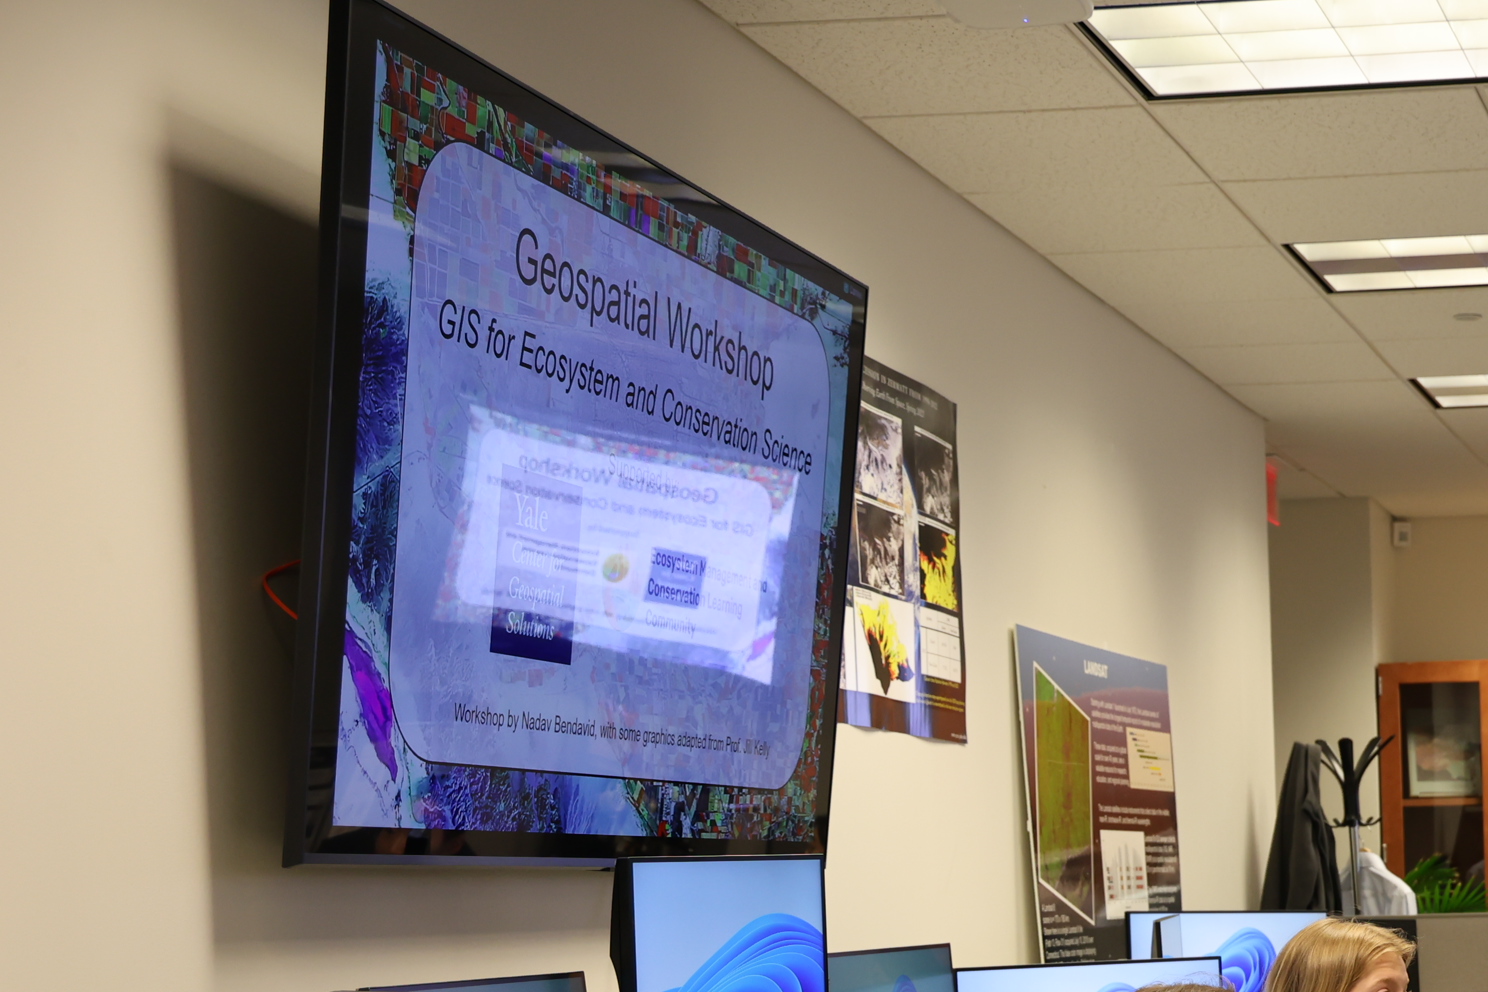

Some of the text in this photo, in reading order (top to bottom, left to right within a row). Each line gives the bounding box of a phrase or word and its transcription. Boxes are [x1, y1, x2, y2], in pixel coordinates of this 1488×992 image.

[515, 227, 774, 401] Geospatial Workshop
[439, 298, 812, 476] GIS for Ecosystem and Conservation Science
[608, 453, 662, 487] Supported
[514, 492, 549, 533] Yale
[511, 540, 547, 569] Center
[545, 547, 565, 578] for
[651, 551, 698, 577] Ecosystem
[508, 576, 565, 611] Geospatial
[647, 577, 743, 621] Conservation Learning
[505, 611, 555, 641] Solutions
[645, 609, 696, 639] Community
[1083, 658, 1109, 679] LANDSAT
[454, 702, 505, 732] Workshop
[507, 709, 519, 733] by
[521, 711, 552, 733] Nadav
[554, 715, 597, 740] Bendavid,
[600, 721, 616, 740] with
[618, 727, 641, 743] some
[642, 728, 675, 748] graphics
[677, 731, 707, 753] adapted
[708, 734, 724, 752] from
[725, 736, 742, 754] Prof.
